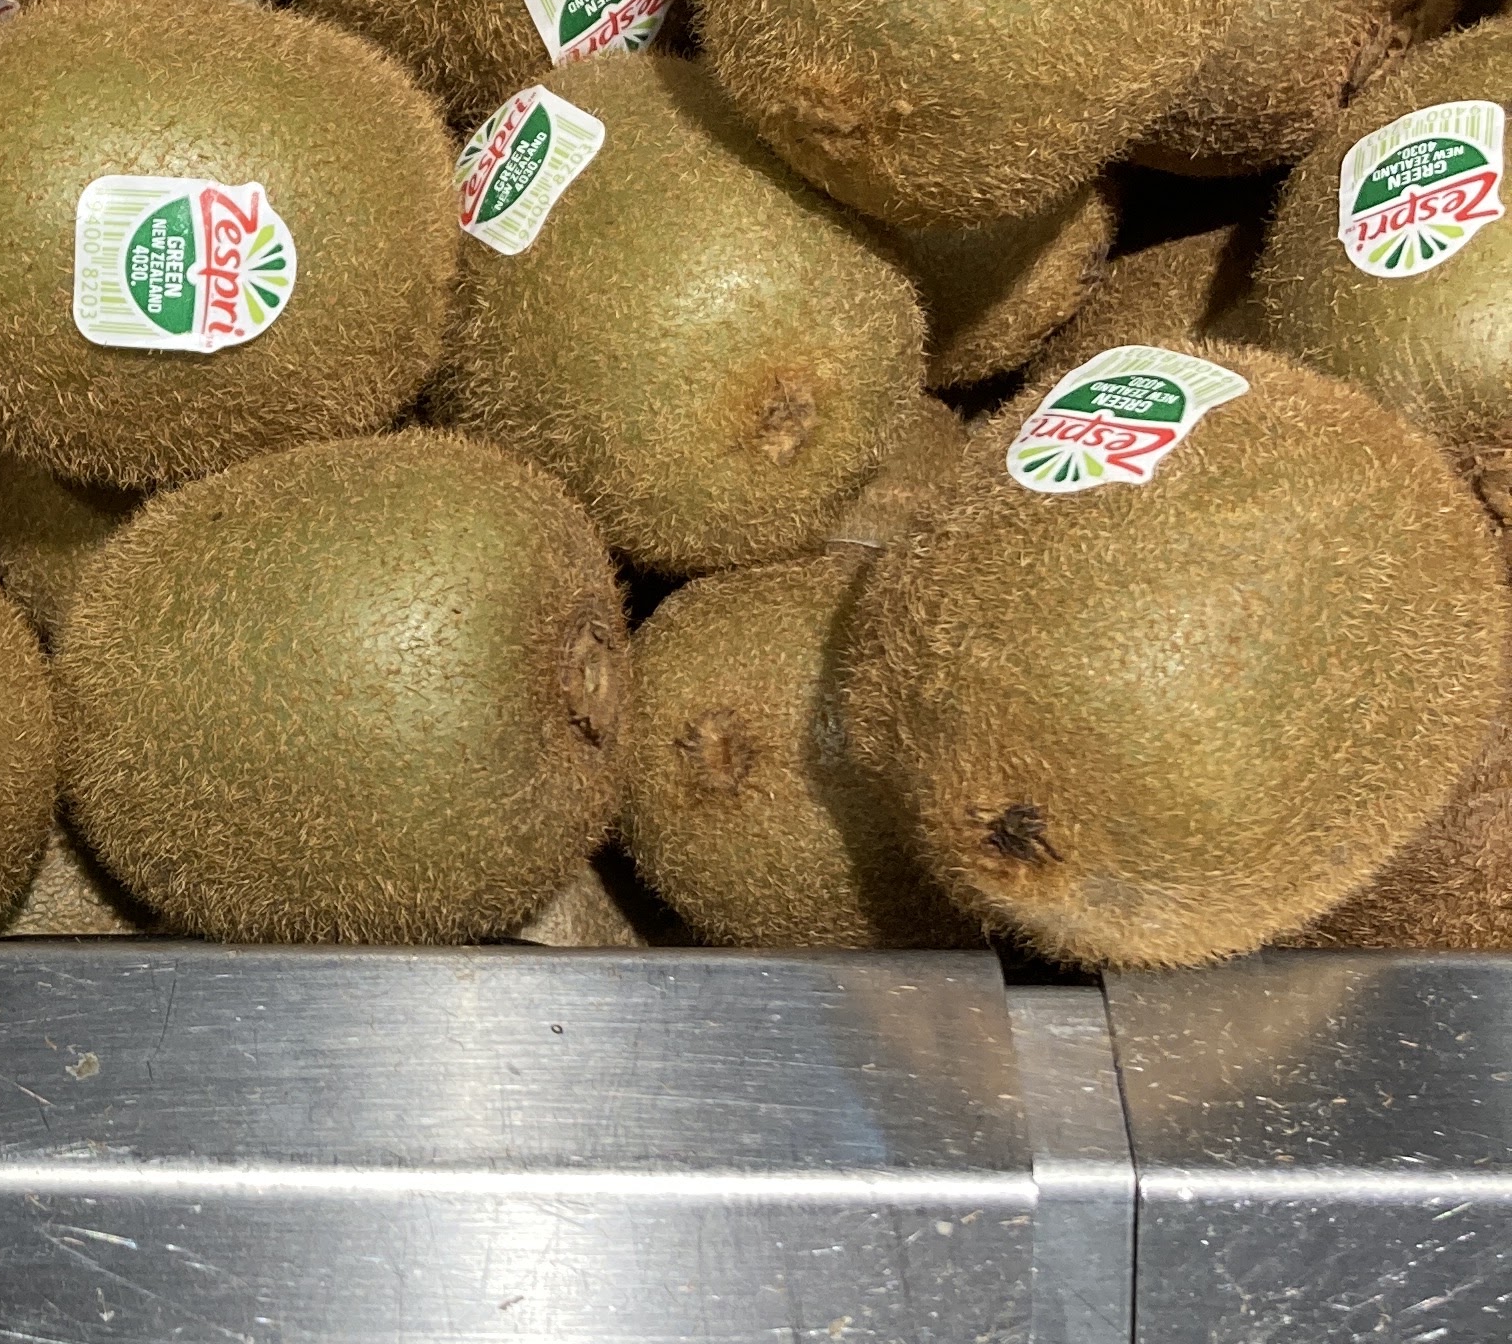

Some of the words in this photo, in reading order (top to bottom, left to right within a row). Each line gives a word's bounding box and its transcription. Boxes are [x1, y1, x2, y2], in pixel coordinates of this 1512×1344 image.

[493, 138, 531, 192] GREEN
[1372, 155, 1432, 182] ZEALAND
[1432, 145, 1465, 163] NEW
[1387, 160, 1448, 190] GREEN
[1353, 170, 1498, 252] Zespri
[151, 218, 167, 250] NEW
[164, 236, 186, 298] GREEN
[198, 187, 260, 337] Zespri
[147, 252, 164, 314] ZEALAND
[1090, 381, 1148, 400] ZEALAND
[1090, 392, 1153, 414] GREEN
[1146, 391, 1180, 405] NEW
[1020, 413, 1176, 476] Zespri
